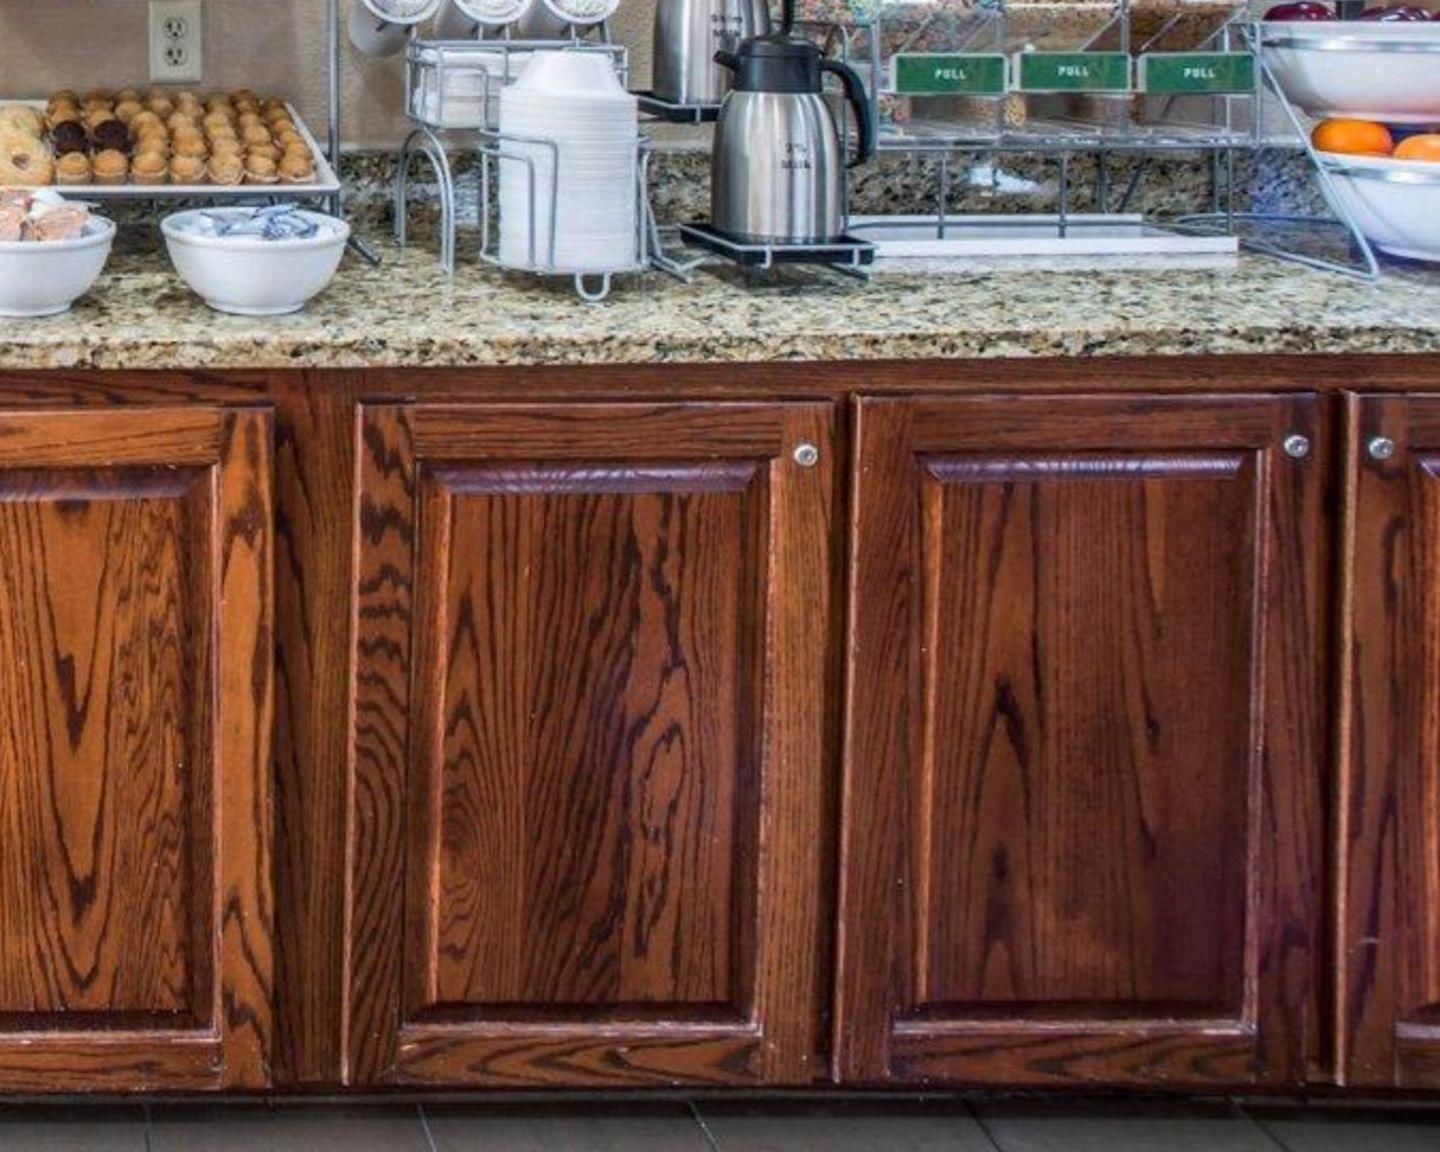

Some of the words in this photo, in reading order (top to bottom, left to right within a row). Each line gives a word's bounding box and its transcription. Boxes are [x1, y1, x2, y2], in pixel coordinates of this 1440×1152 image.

[934, 68, 966, 80] PULL
[1058, 65, 1090, 77] PULL
[1183, 67, 1216, 79] PULL
